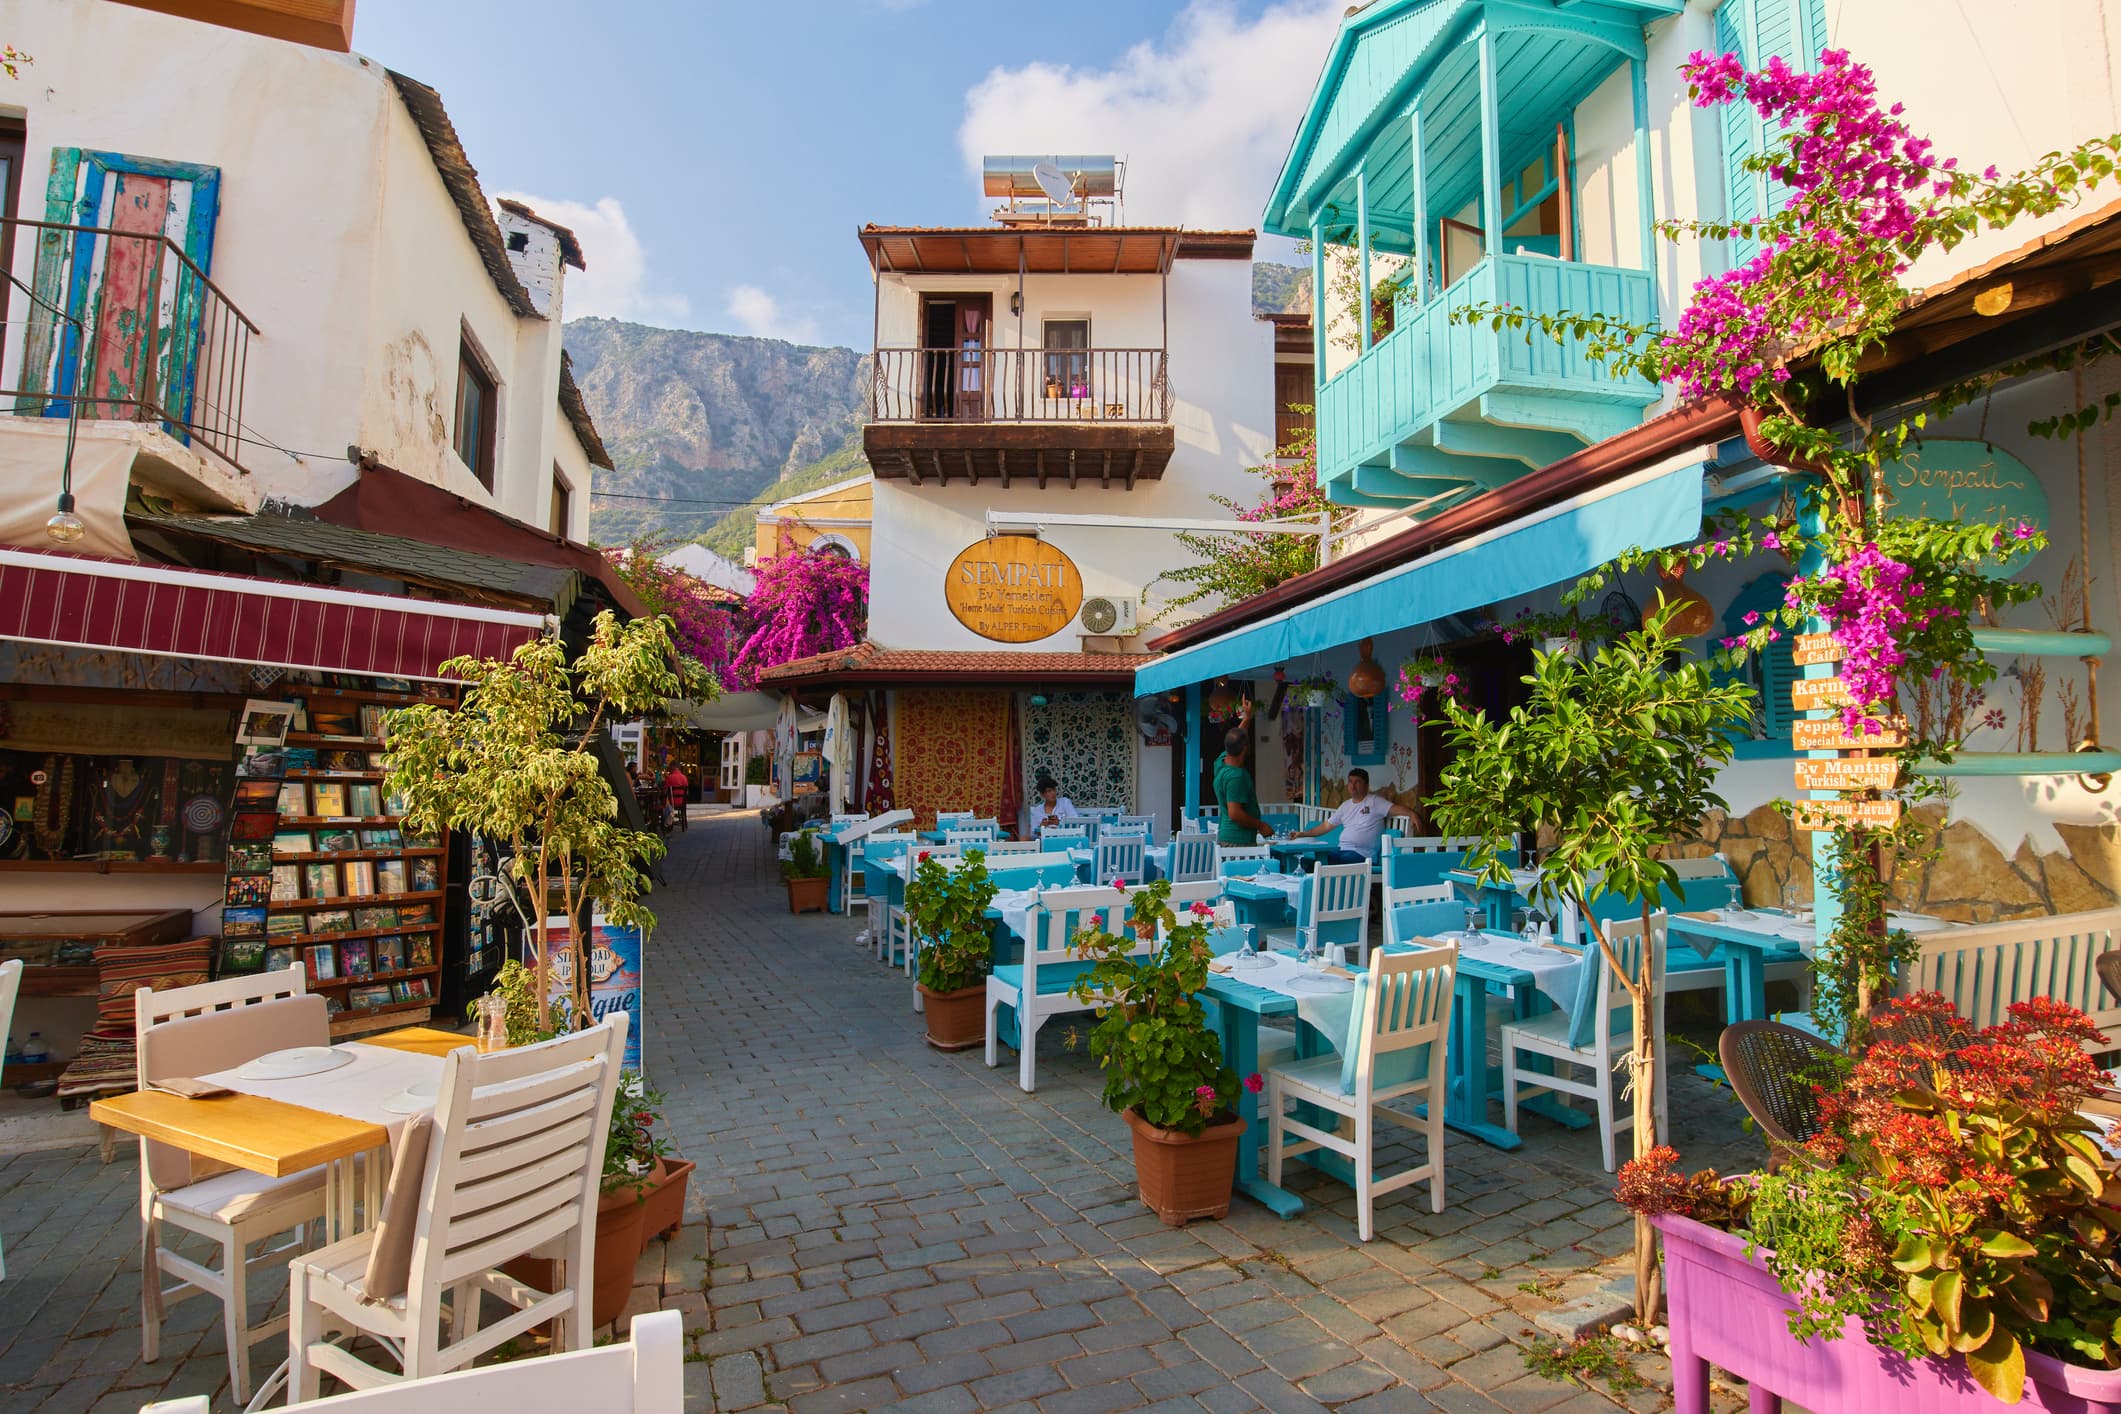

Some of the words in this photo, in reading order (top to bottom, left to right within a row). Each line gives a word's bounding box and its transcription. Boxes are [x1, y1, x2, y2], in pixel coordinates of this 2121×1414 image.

[978, 588, 994, 600] Ev
[997, 588, 1053, 602] Yemekleri
[1007, 603, 1037, 615] Turkish
[979, 621, 989, 633] By
[991, 622, 1019, 632] ALPER
[1022, 622, 1048, 634] Family
[1807, 649, 1835, 663] Calf
[1800, 736, 1835, 748] Special
[1795, 762, 1818, 774] Ev
[1825, 761, 1897, 774] Mantısı
[1804, 774, 1847, 787] Turkish
